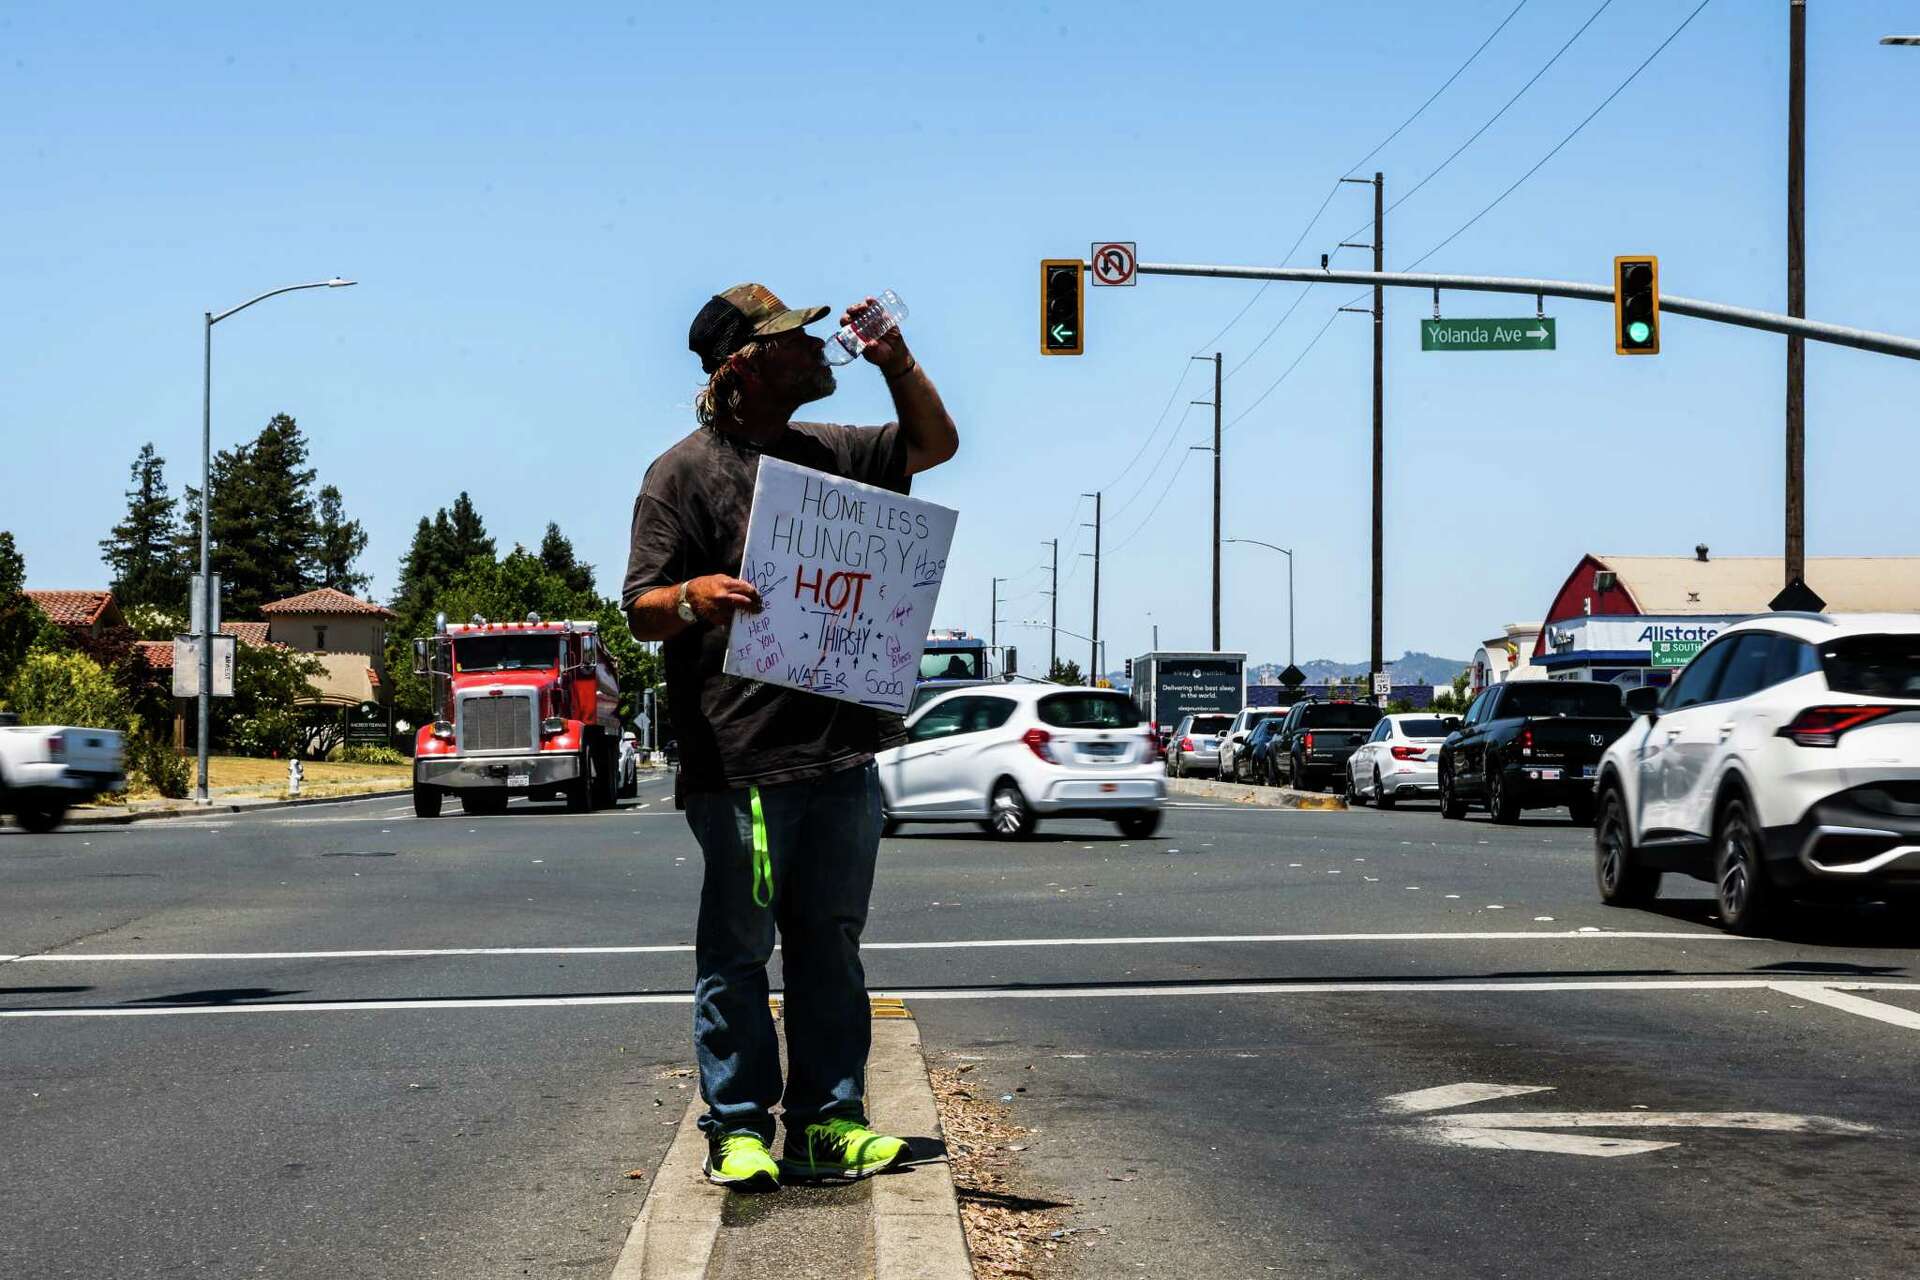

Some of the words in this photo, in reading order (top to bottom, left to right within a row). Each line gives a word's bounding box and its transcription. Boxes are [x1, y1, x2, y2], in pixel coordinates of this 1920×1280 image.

[1428, 326, 1488, 343] Yolanda
[1494, 326, 1521, 343] Ave
[771, 514, 914, 575] HUNGRY
[795, 564, 872, 614] HOT
[1638, 626, 1718, 642] Allstate
[1672, 643, 1701, 652] SOUTH
[787, 664, 849, 688] WATER
[1162, 684, 1193, 693] Delivering
[1193, 684, 1204, 692] the
[1204, 684, 1218, 692] best
[1219, 684, 1236, 694] sleep
[1376, 684, 1389, 692] 35
